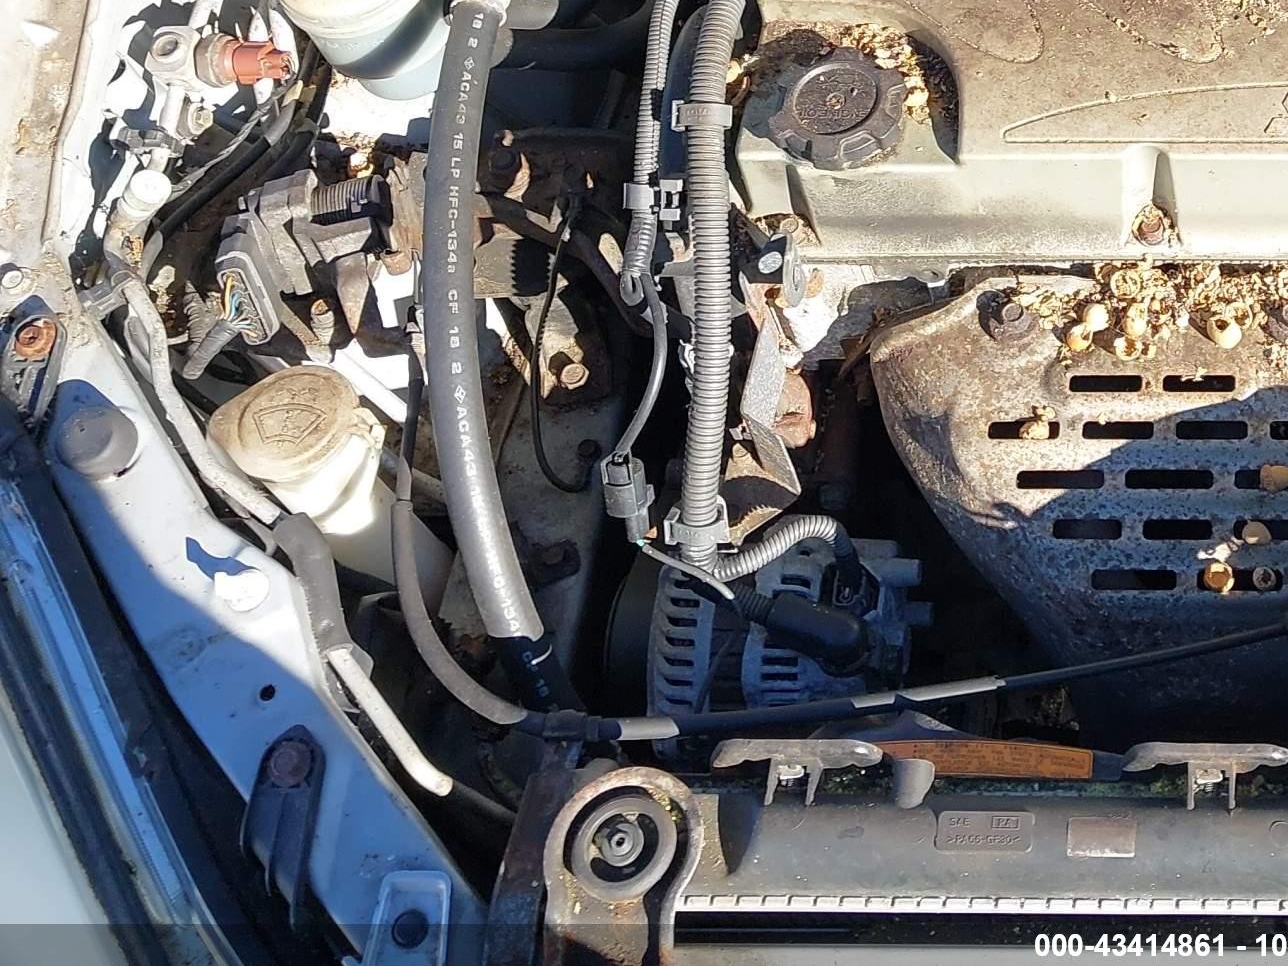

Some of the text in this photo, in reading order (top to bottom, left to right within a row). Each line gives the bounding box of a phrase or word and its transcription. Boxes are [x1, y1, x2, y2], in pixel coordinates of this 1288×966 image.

[452, 132, 464, 151] 15
[450, 156, 461, 179] LP
[446, 185, 461, 274] HFC-134a
[447, 289, 460, 314] CF
[455, 405, 477, 477] ACA43
[949, 817, 971, 827] SAE
